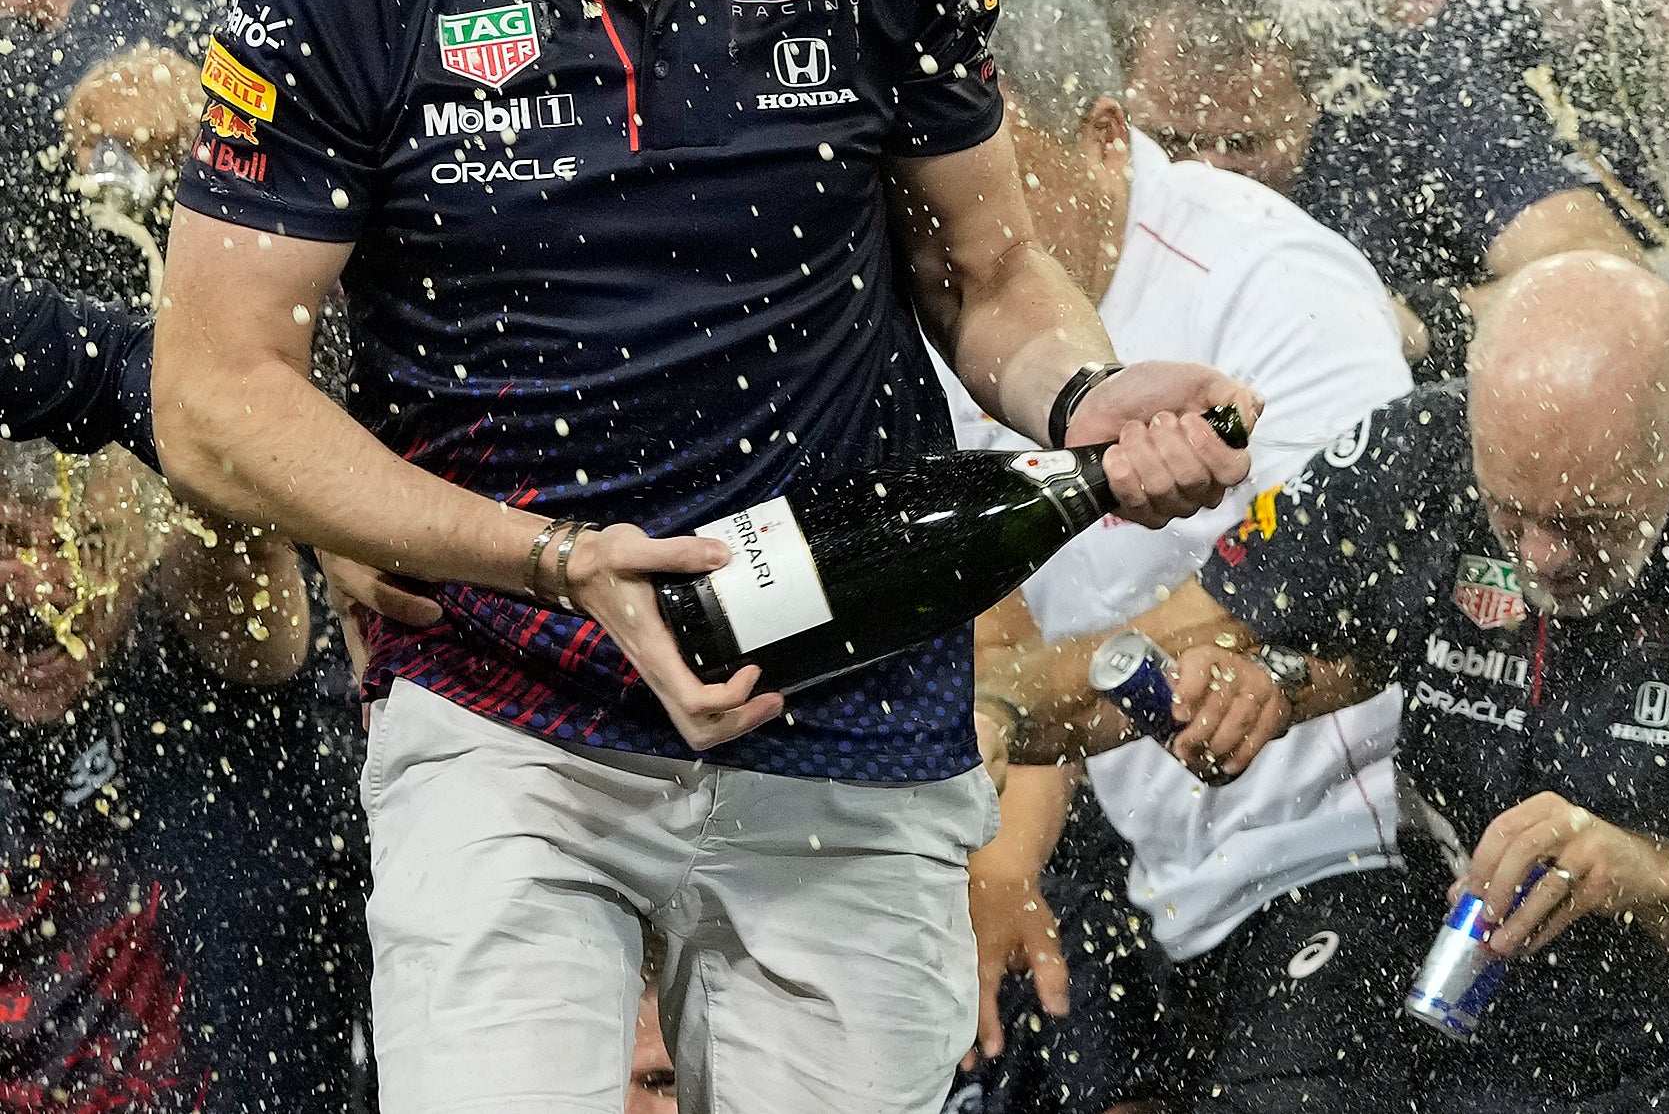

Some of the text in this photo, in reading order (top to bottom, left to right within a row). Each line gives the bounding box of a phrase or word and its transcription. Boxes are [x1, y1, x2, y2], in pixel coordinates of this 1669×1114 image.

[445, 11, 527, 43] TAG
[447, 41, 533, 81] HEUER
[423, 97, 561, 136] Mobil 1
[756, 88, 859, 110] HONDA
[431, 156, 578, 184] ORACLE
[1426, 635, 1506, 682] Mobil
[1415, 681, 1528, 732] ORACLE
